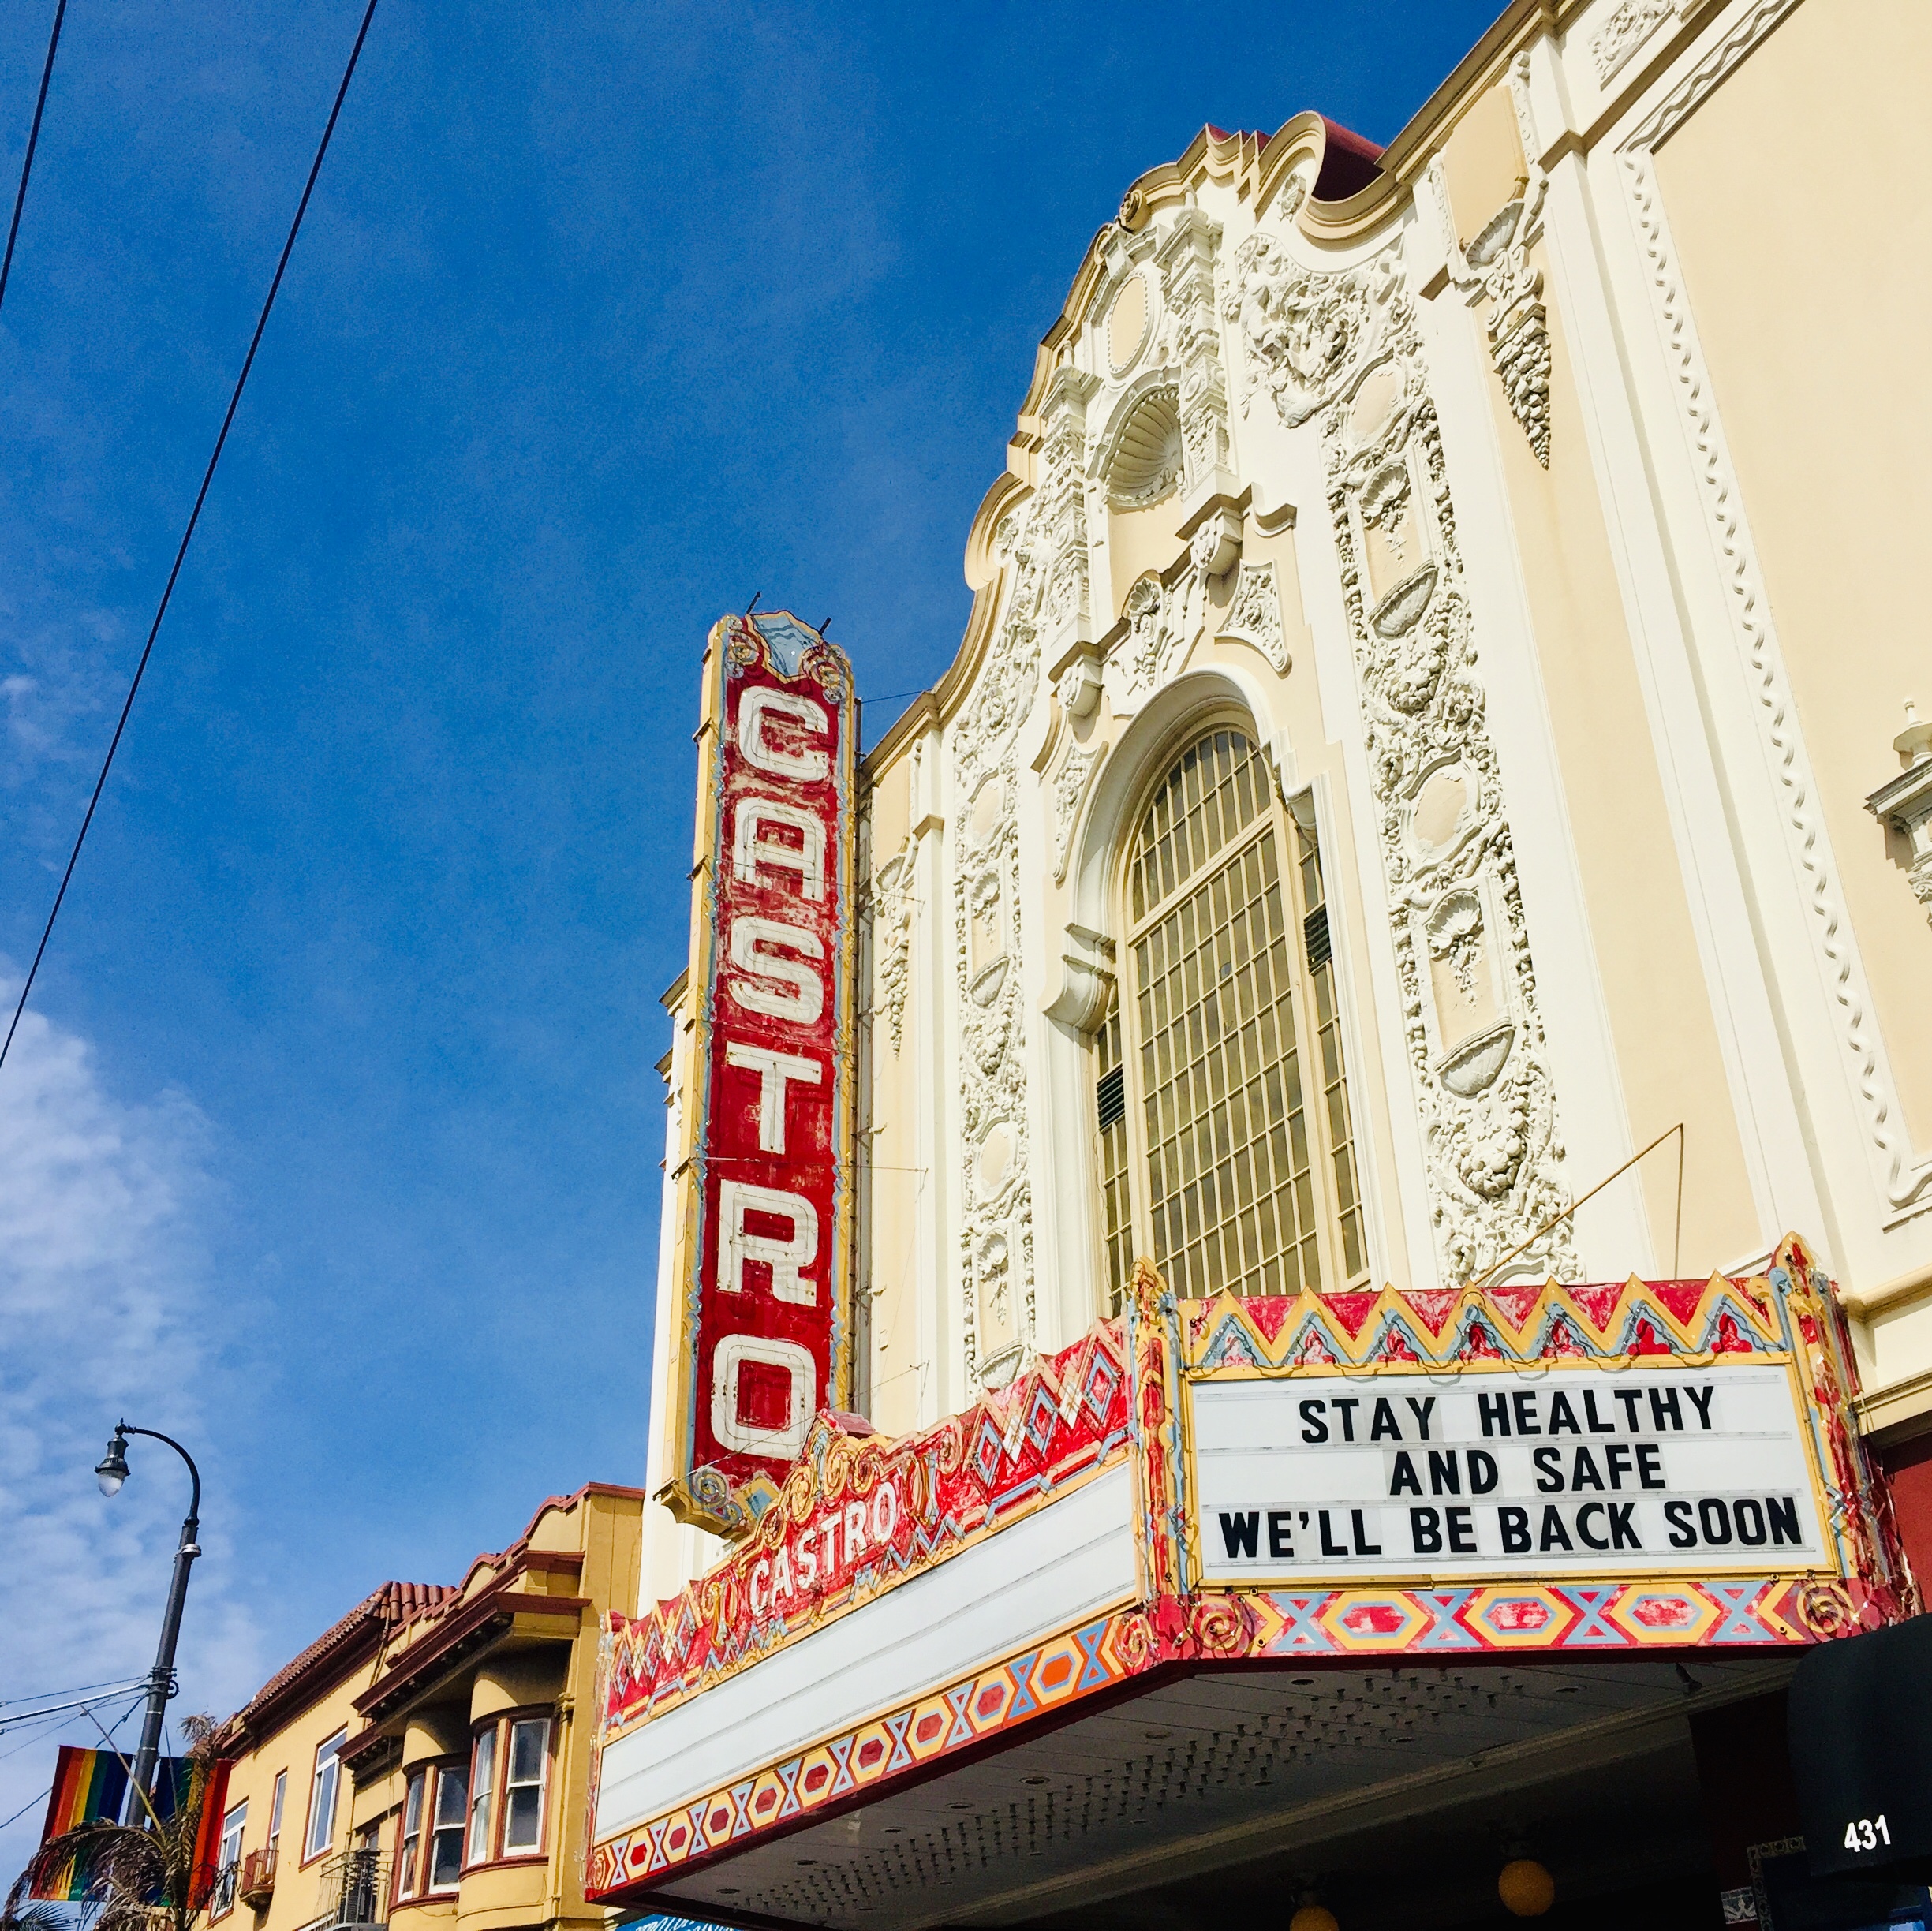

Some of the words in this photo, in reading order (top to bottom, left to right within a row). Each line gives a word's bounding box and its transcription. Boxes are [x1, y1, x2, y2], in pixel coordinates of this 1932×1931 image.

[711, 685, 829, 1461] CASTRO
[1299, 1396, 1437, 1444] STAY
[1477, 1385, 1714, 1437] HEALTHY
[1389, 1449, 1500, 1496] AND
[1533, 1444, 1666, 1492] SAFE
[750, 1481, 896, 1616] CASTRO
[1218, 1508, 1382, 1559] WE'LL
[1409, 1506, 1478, 1554] BE
[1497, 1502, 1643, 1554] BACK
[1663, 1496, 1803, 1548] SOON
[1844, 1814, 1892, 1853] 431
